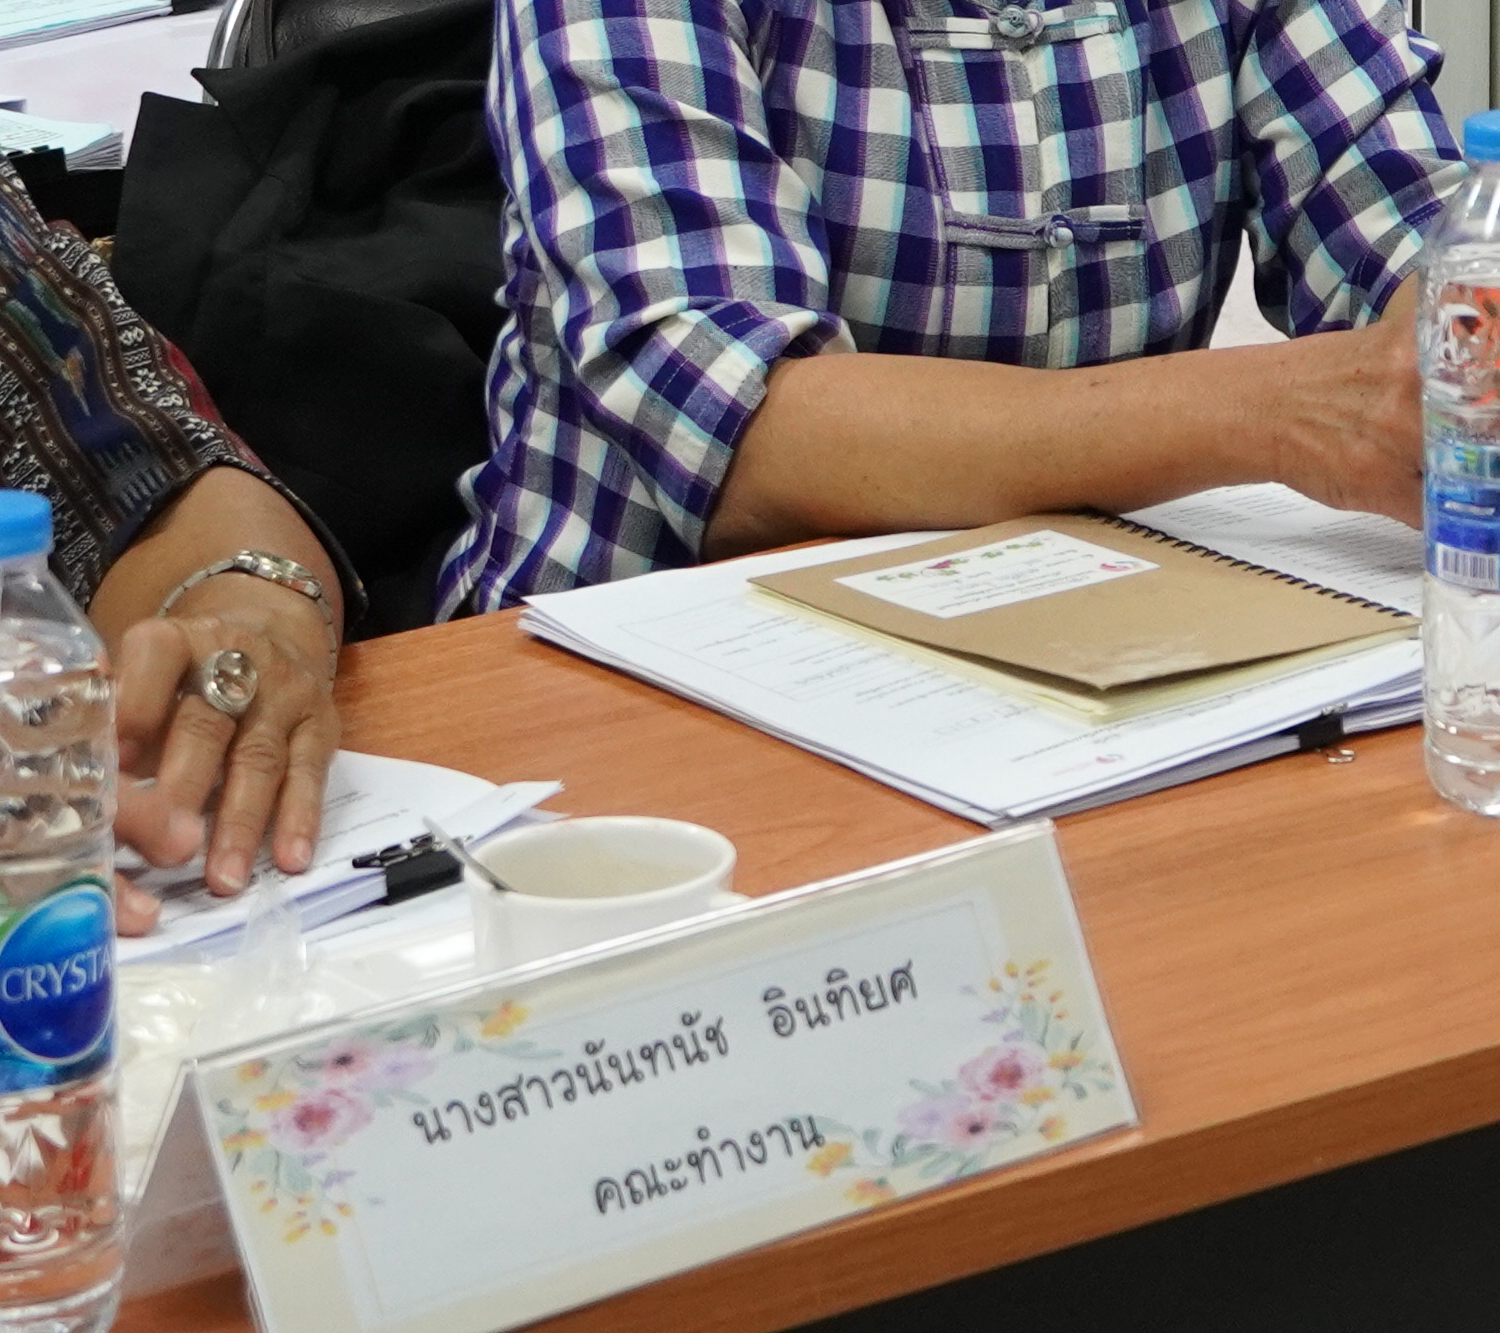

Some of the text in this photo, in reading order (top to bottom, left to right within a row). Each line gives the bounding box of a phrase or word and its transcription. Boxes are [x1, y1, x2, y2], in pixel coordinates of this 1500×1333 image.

[1, 944, 112, 1003] CRYSTA
[413, 957, 920, 1147] นางสาวนันทนัช อินทิยศ
[591, 1112, 826, 1218] คณะทำงาน
